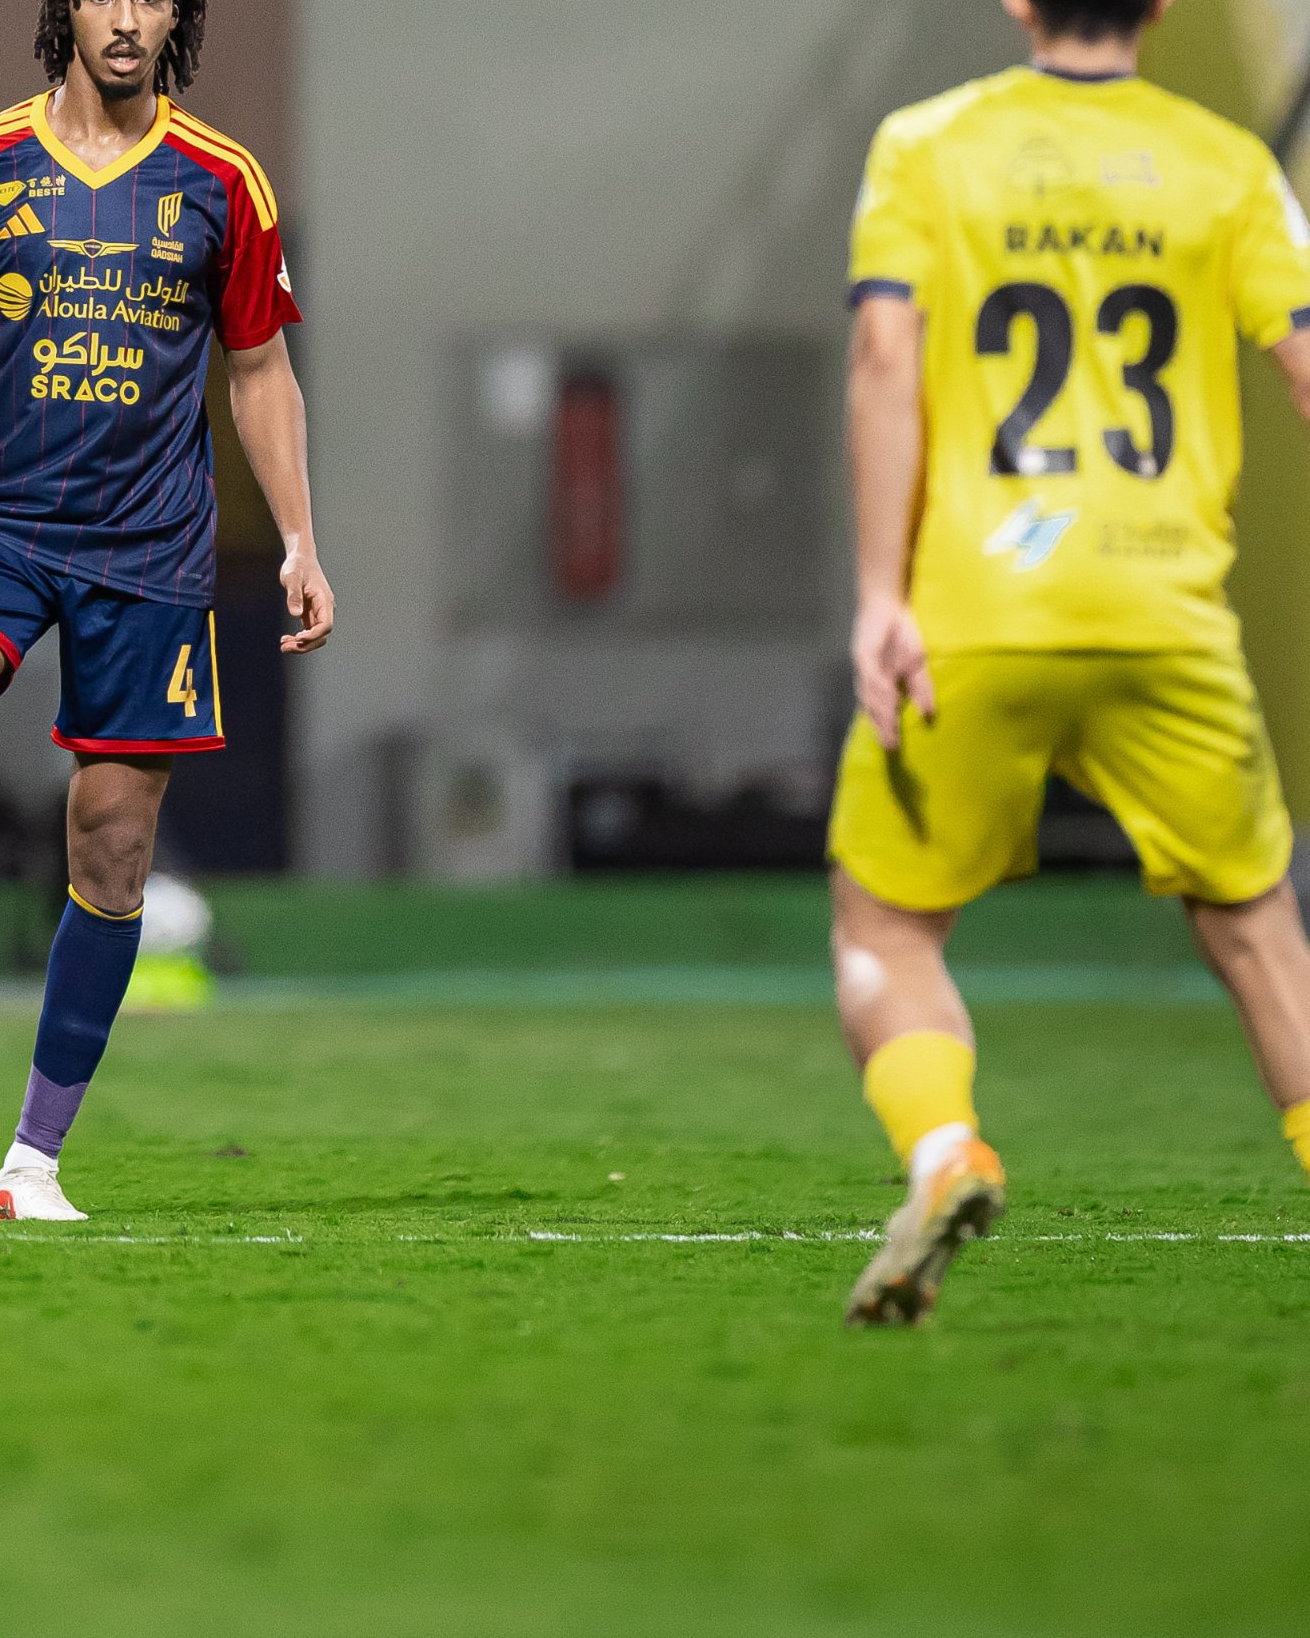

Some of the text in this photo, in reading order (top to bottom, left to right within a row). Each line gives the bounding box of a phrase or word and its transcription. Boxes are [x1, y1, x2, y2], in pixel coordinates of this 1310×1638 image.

[28, 187, 65, 198] BESTE
[151, 248, 183, 264] QADSIAH
[1003, 223, 1165, 259] RAKAN
[38, 265, 122, 295] للطيران
[36, 295, 180, 332] Aloula Aviation
[32, 331, 145, 377] سراكو
[30, 374, 140, 405] SRACO
[975, 281, 1180, 481] 23
[167, 644, 198, 717] 4
